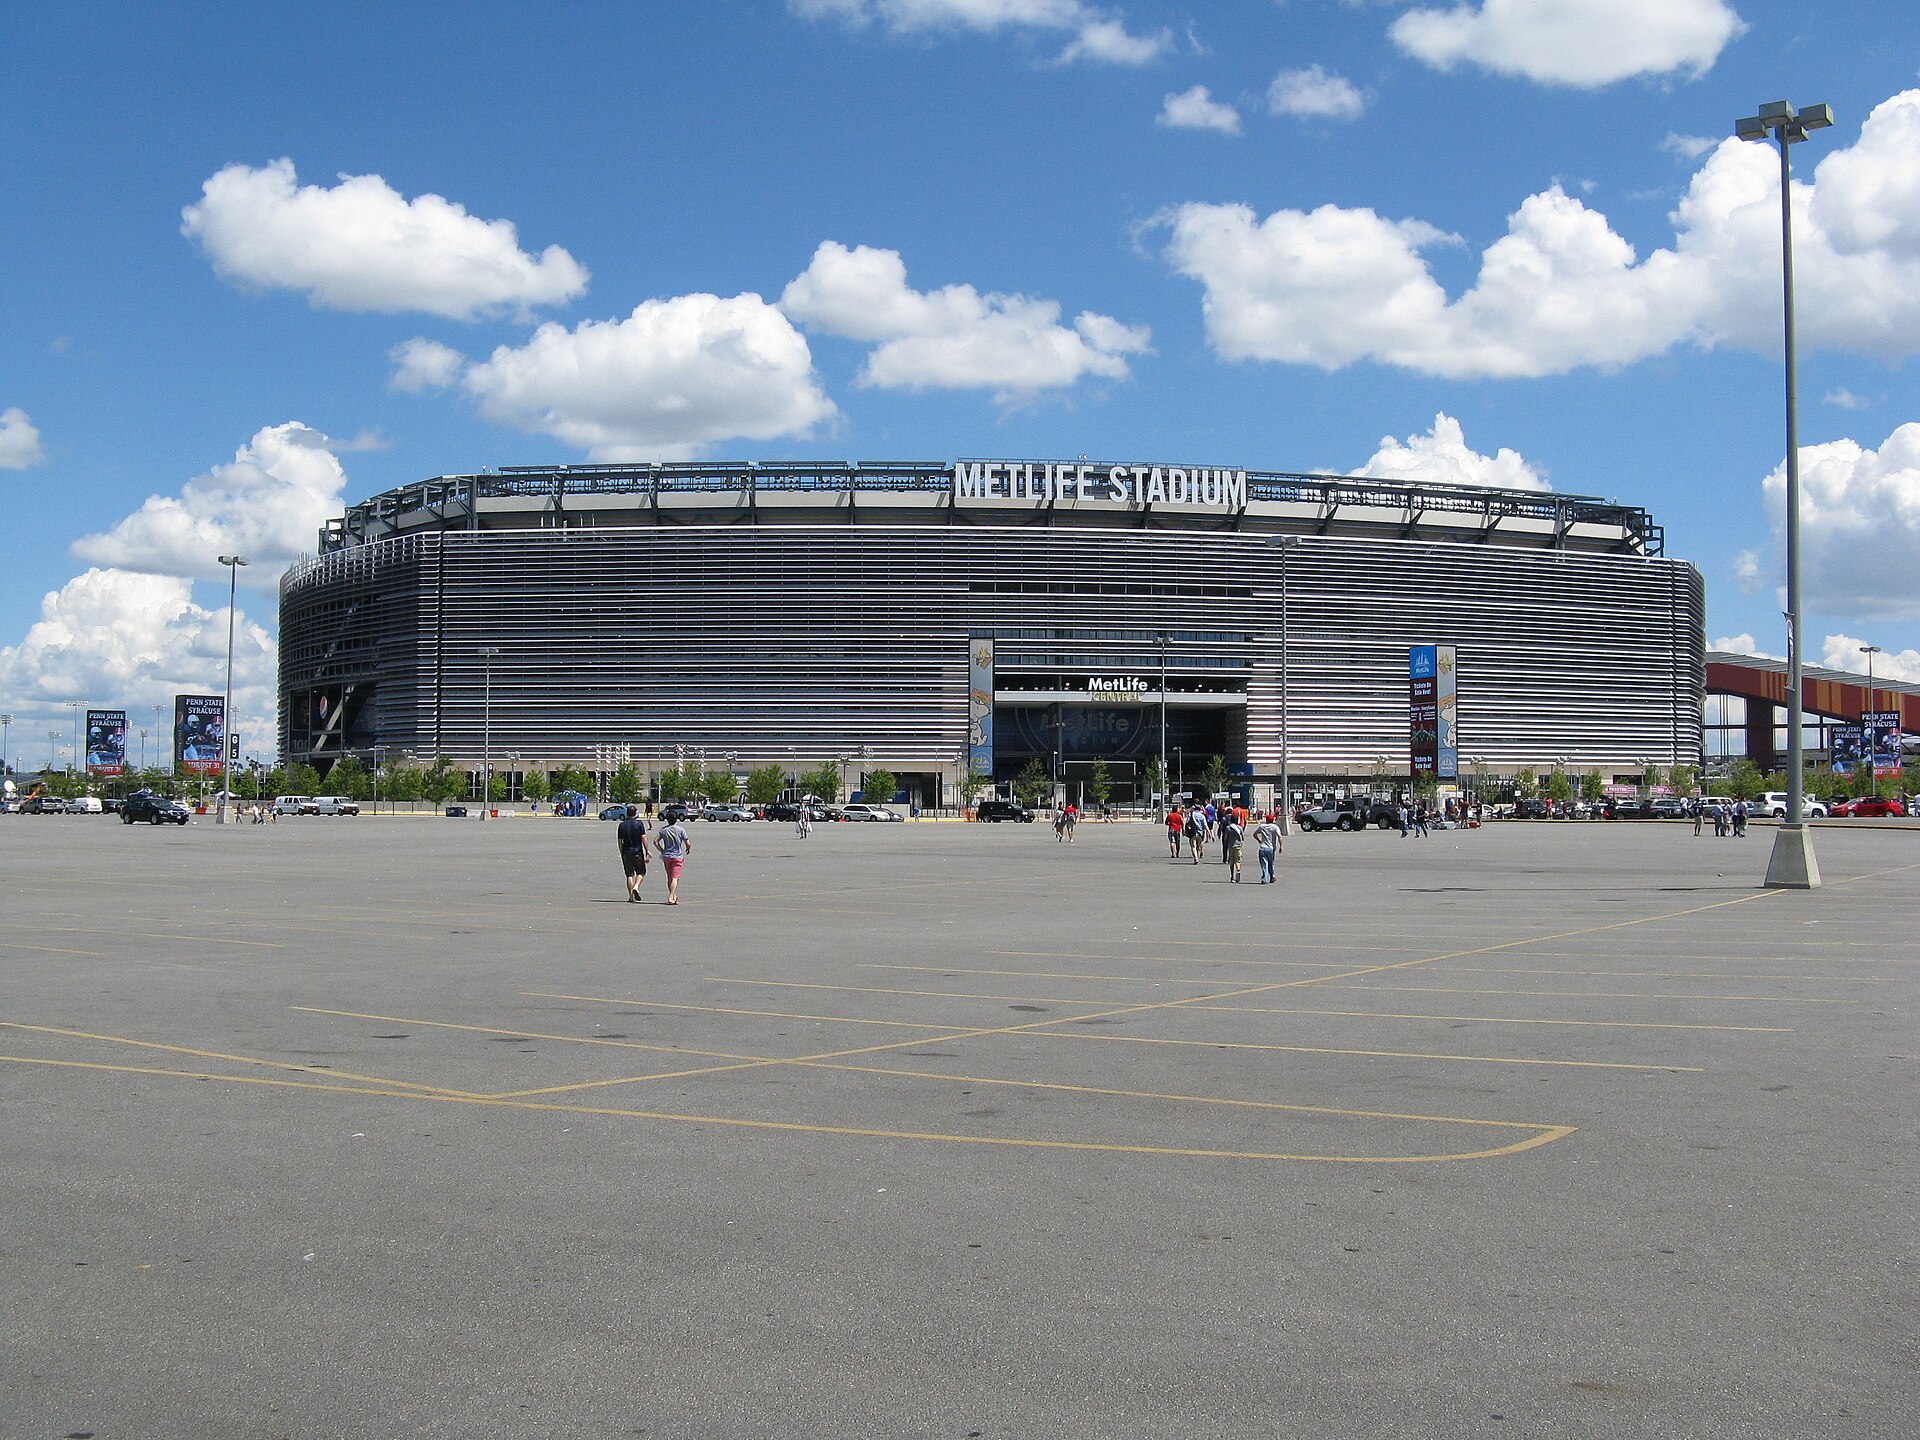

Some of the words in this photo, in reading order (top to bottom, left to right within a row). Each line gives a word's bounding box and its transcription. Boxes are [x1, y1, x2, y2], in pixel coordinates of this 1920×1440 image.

[955, 463, 1095, 501] METLIFE
[1109, 466, 1247, 507] STADIUM
[1088, 676, 1148, 691] MetLife
[1091, 692, 1143, 702] CENTRAL
[232, 749, 237, 757] 5
